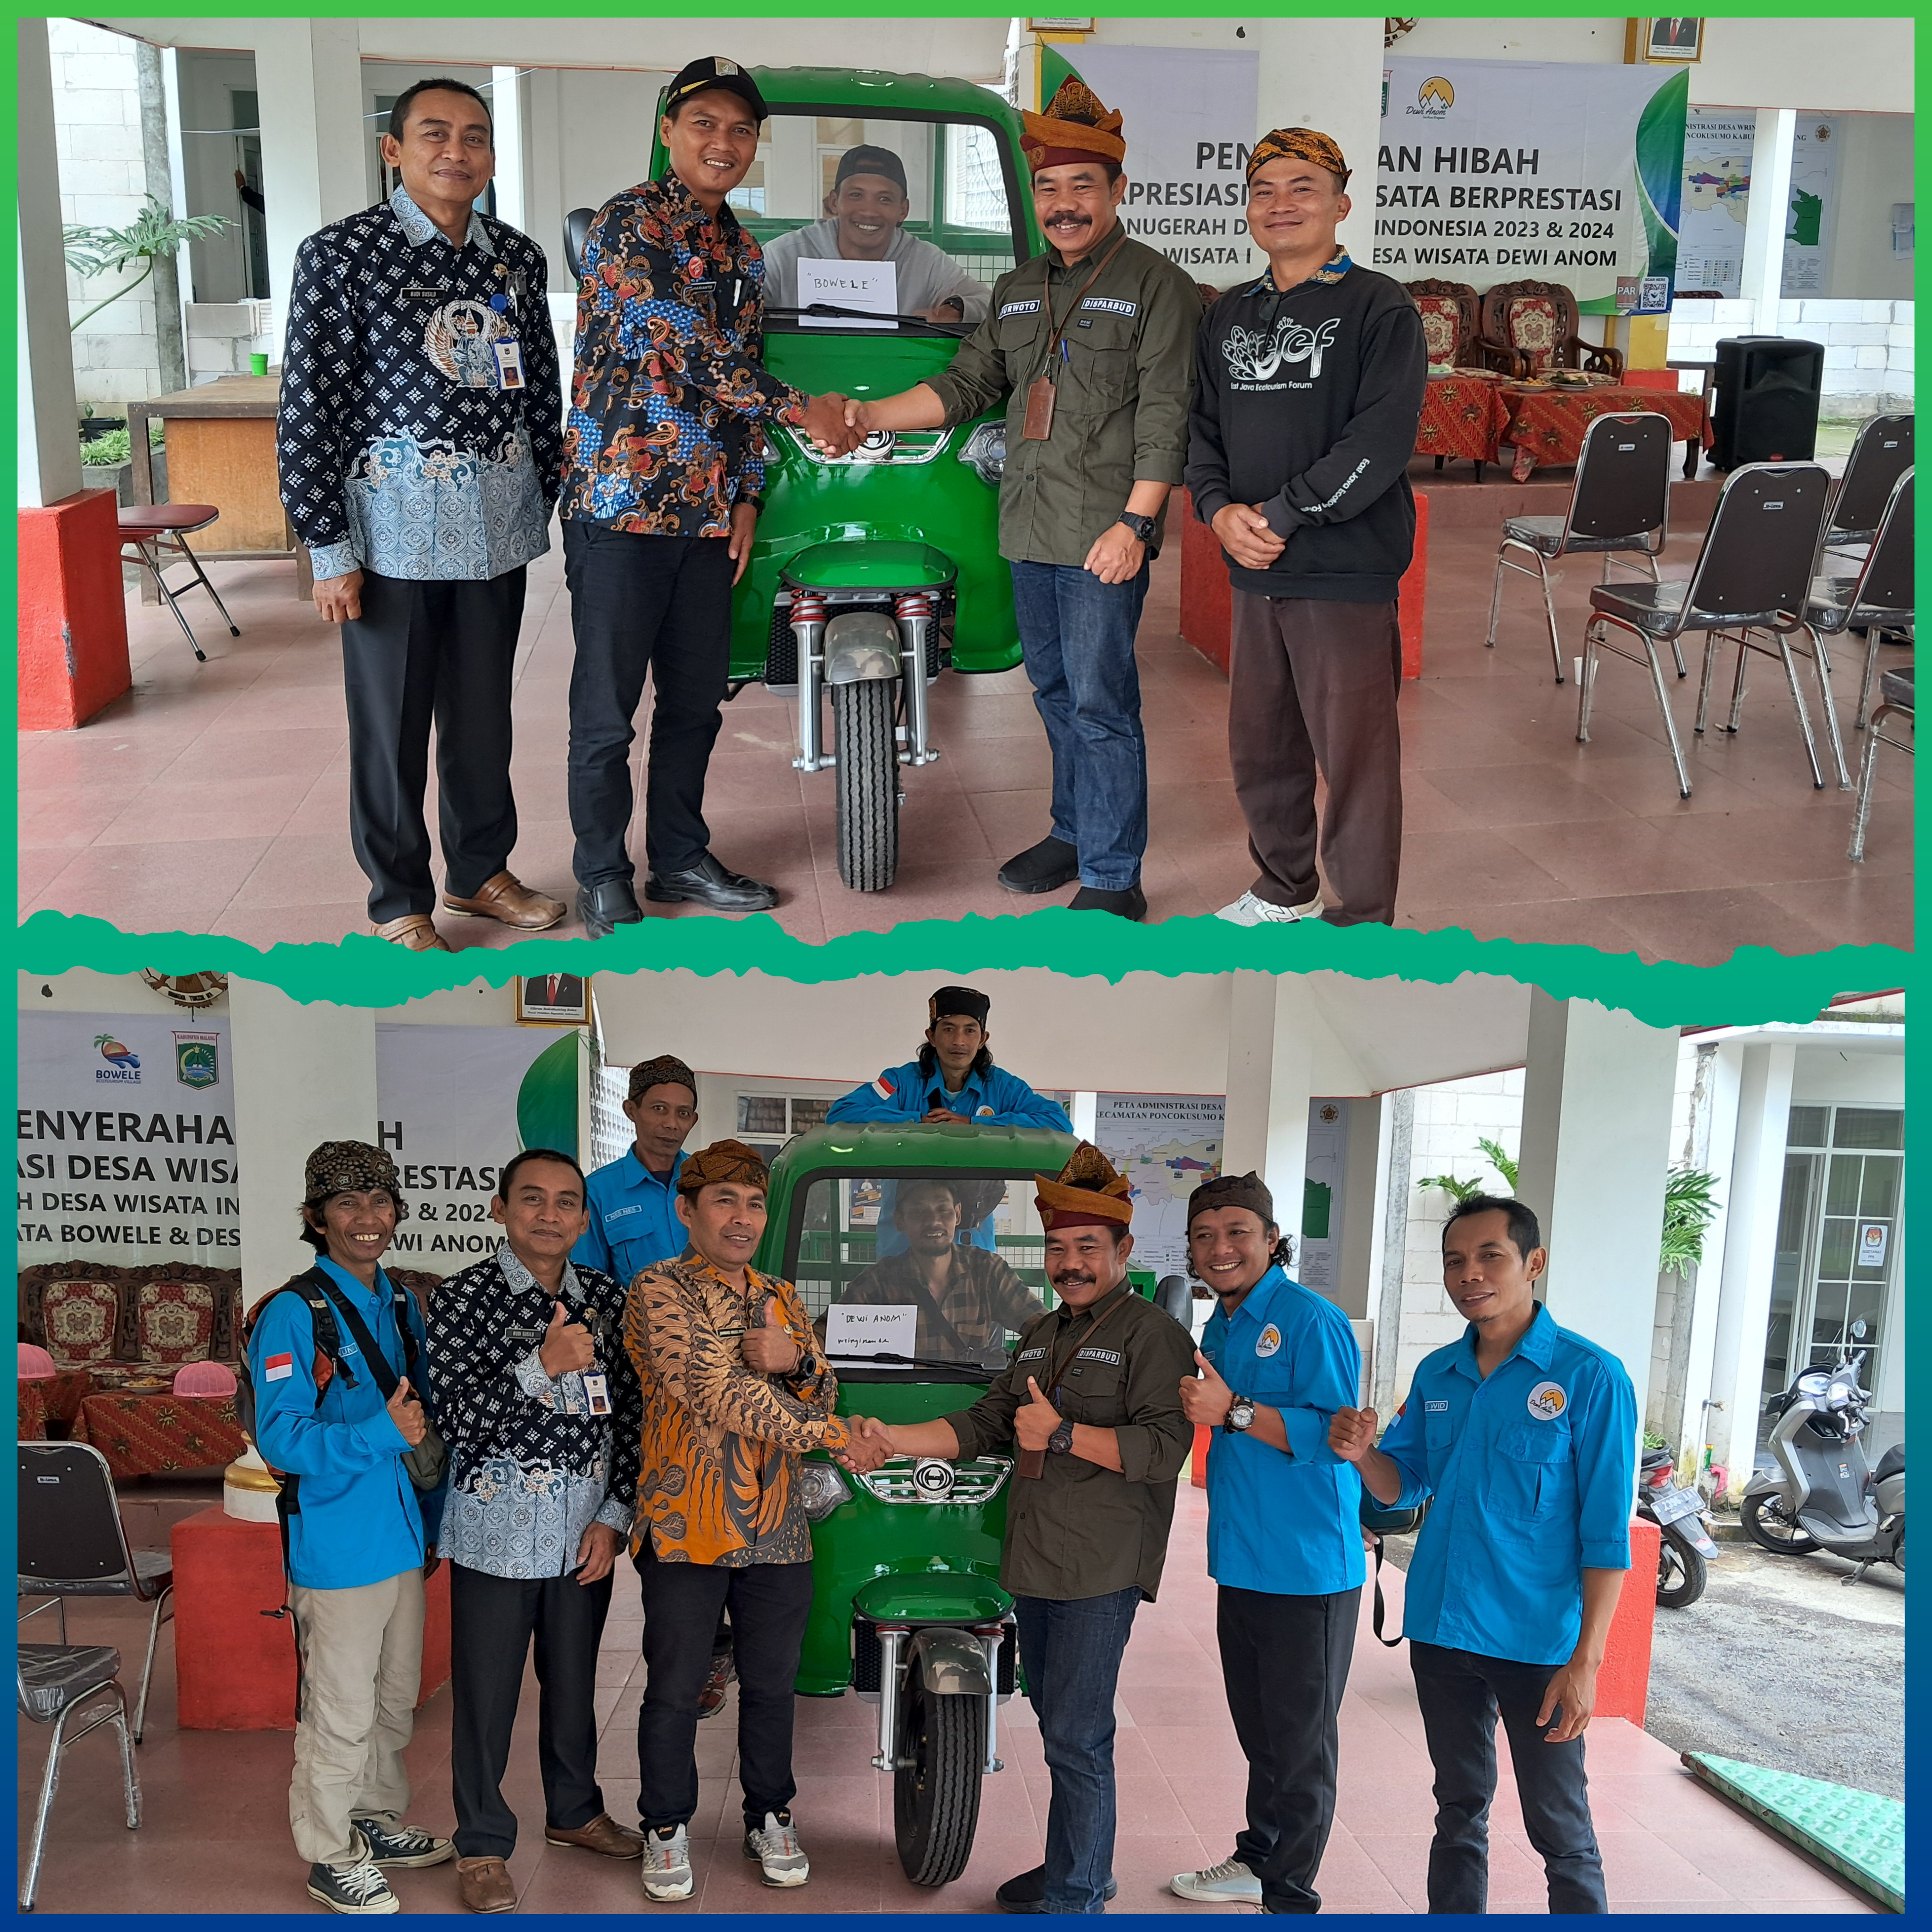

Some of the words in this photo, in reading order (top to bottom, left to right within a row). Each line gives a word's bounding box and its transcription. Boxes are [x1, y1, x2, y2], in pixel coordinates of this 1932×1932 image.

[1406, 106, 1424, 115] Dewi
[1425, 107, 1446, 115] Anom
[1434, 146, 1539, 175] HIBAH
[1450, 186, 1621, 211] BERPRESTASI
[1374, 219, 1488, 236] INDONESIA
[1493, 220, 1540, 237] 2023
[1546, 221, 1563, 238] &
[1569, 222, 1615, 239] 2024
[1163, 247, 1236, 264] WISATA
[1415, 248, 1490, 265] WISATA
[1497, 249, 1548, 266] DEWI
[1554, 250, 1617, 266] ANOM
[1617, 286, 1636, 295] PAR
[1085, 300, 1132, 313] DISPARBUD
[1240, 383, 1254, 391] Java
[1288, 381, 1313, 389] Forum
[1342, 471, 1358, 490] Java
[96, 1069, 141, 1080] BOWELE
[1149, 1112, 1217, 1121] PONCOKUSUMO
[67, 1154, 156, 1182] DESA
[42, 1192, 107, 1212] DESA
[113, 1194, 208, 1215] WISATA
[61, 1224, 161, 1245] BOWELE
[169, 1226, 190, 1246] &
[386, 1233, 422, 1252] WI
[430, 1233, 506, 1253] ANOM
[1079, 1350, 1116, 1362] DISPARBUD
